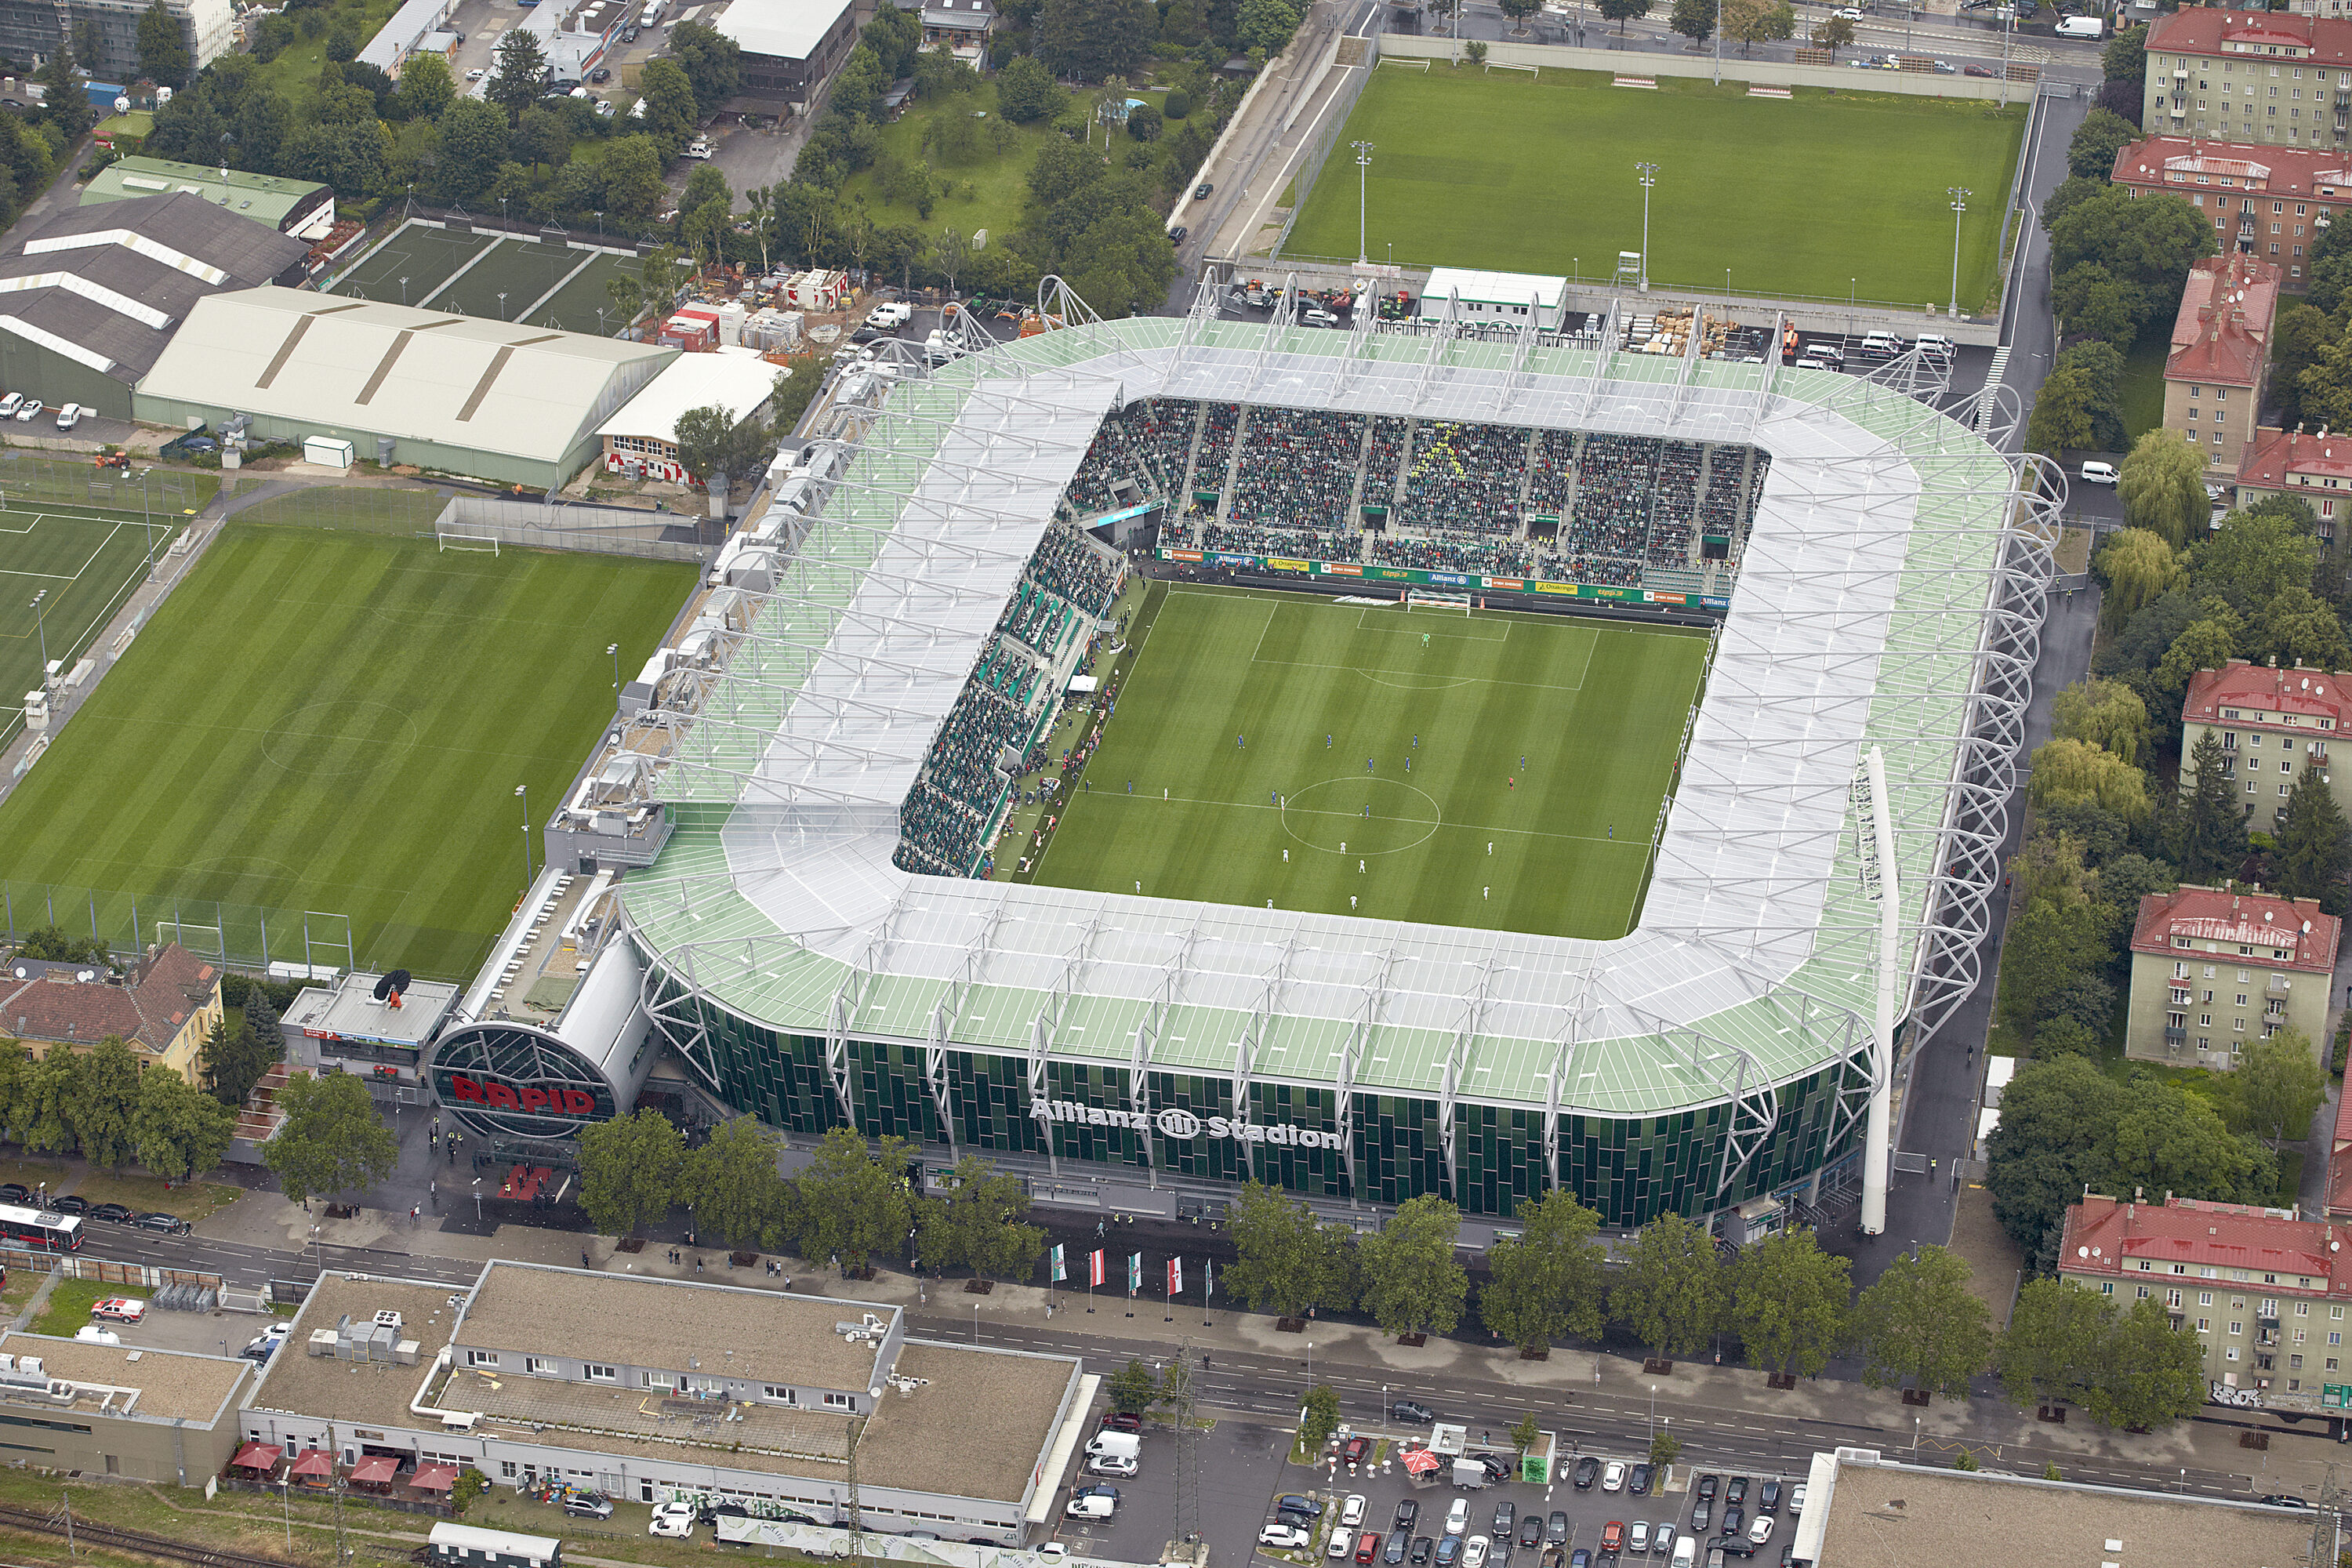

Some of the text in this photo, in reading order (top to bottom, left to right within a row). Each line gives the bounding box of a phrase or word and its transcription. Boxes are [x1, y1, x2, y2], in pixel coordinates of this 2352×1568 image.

[1218, 555, 1242, 564] Allianz
[1703, 597, 1726, 606] Allianz
[452, 1076, 595, 1114] RAPID
[1029, 1098, 1341, 1150] Allianz Stadion
